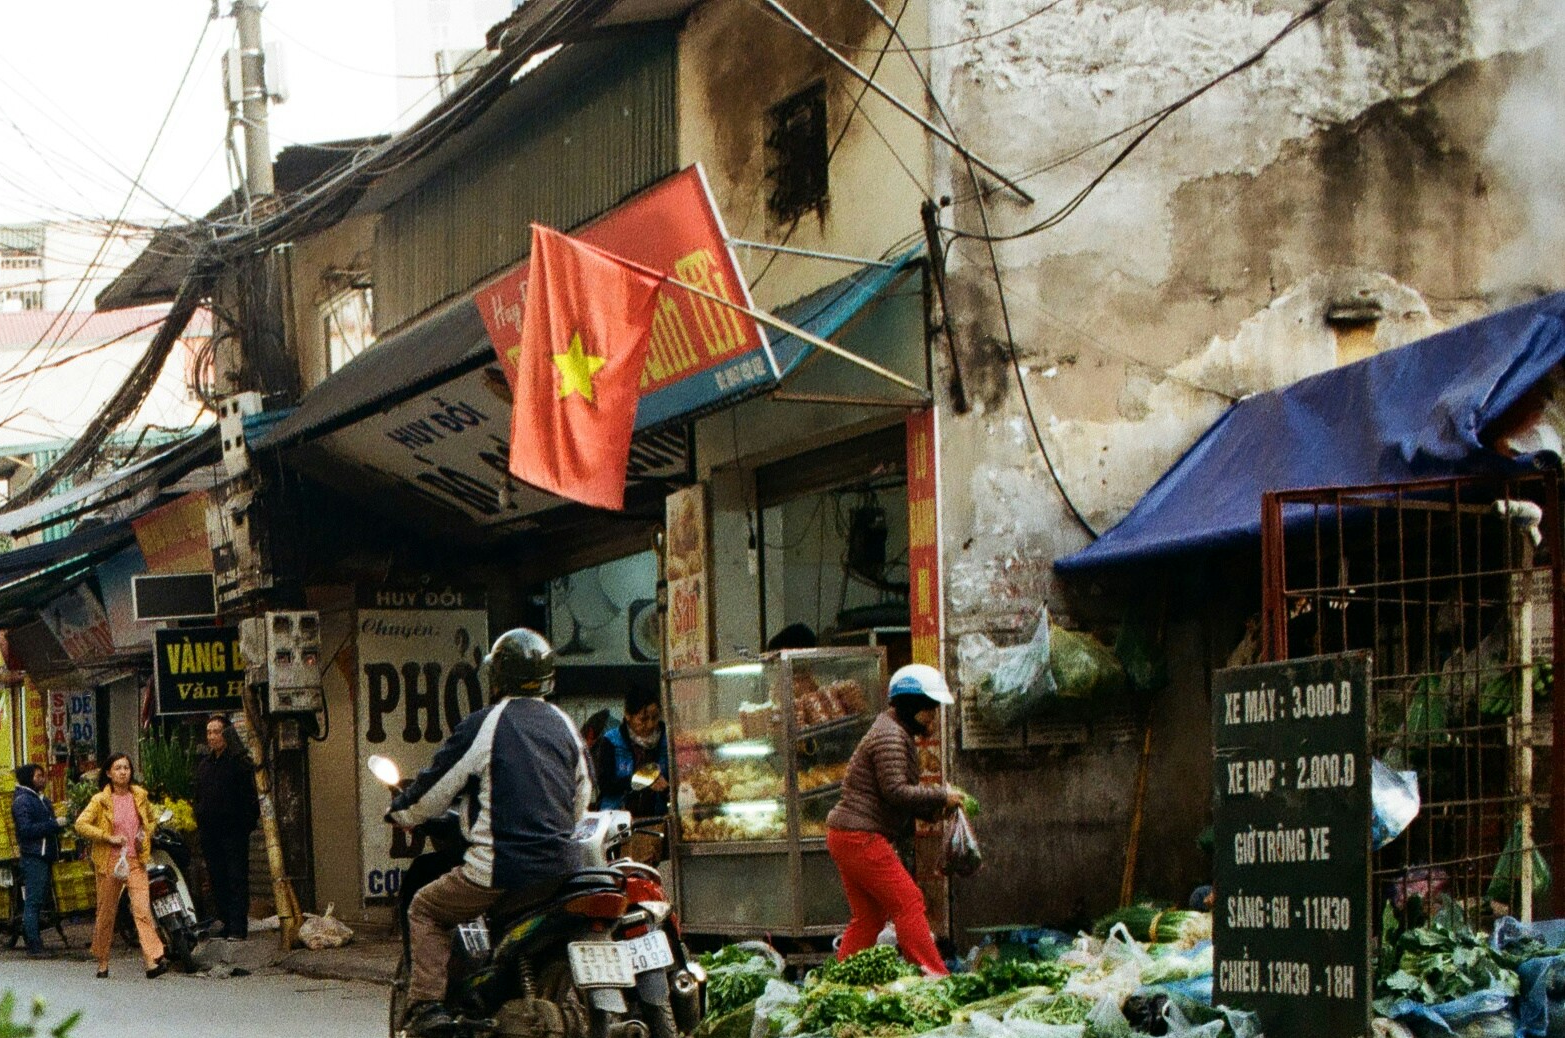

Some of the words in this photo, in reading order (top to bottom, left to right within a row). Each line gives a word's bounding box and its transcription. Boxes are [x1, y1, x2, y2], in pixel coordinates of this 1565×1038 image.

[386, 418, 445, 450] HUY
[375, 590, 415, 606] HUY
[166, 635, 226, 675] VÀNG
[177, 681, 219, 700] Văn
[363, 626, 483, 744] PHỞ
[1225, 692, 1241, 725] XE
[1244, 682, 1276, 724] MÁY
[72, 717, 93, 741] BÒ
[1228, 762, 1244, 795] XE
[1247, 759, 1276, 799] ĐẠP
[1309, 827, 1331, 861] XE
